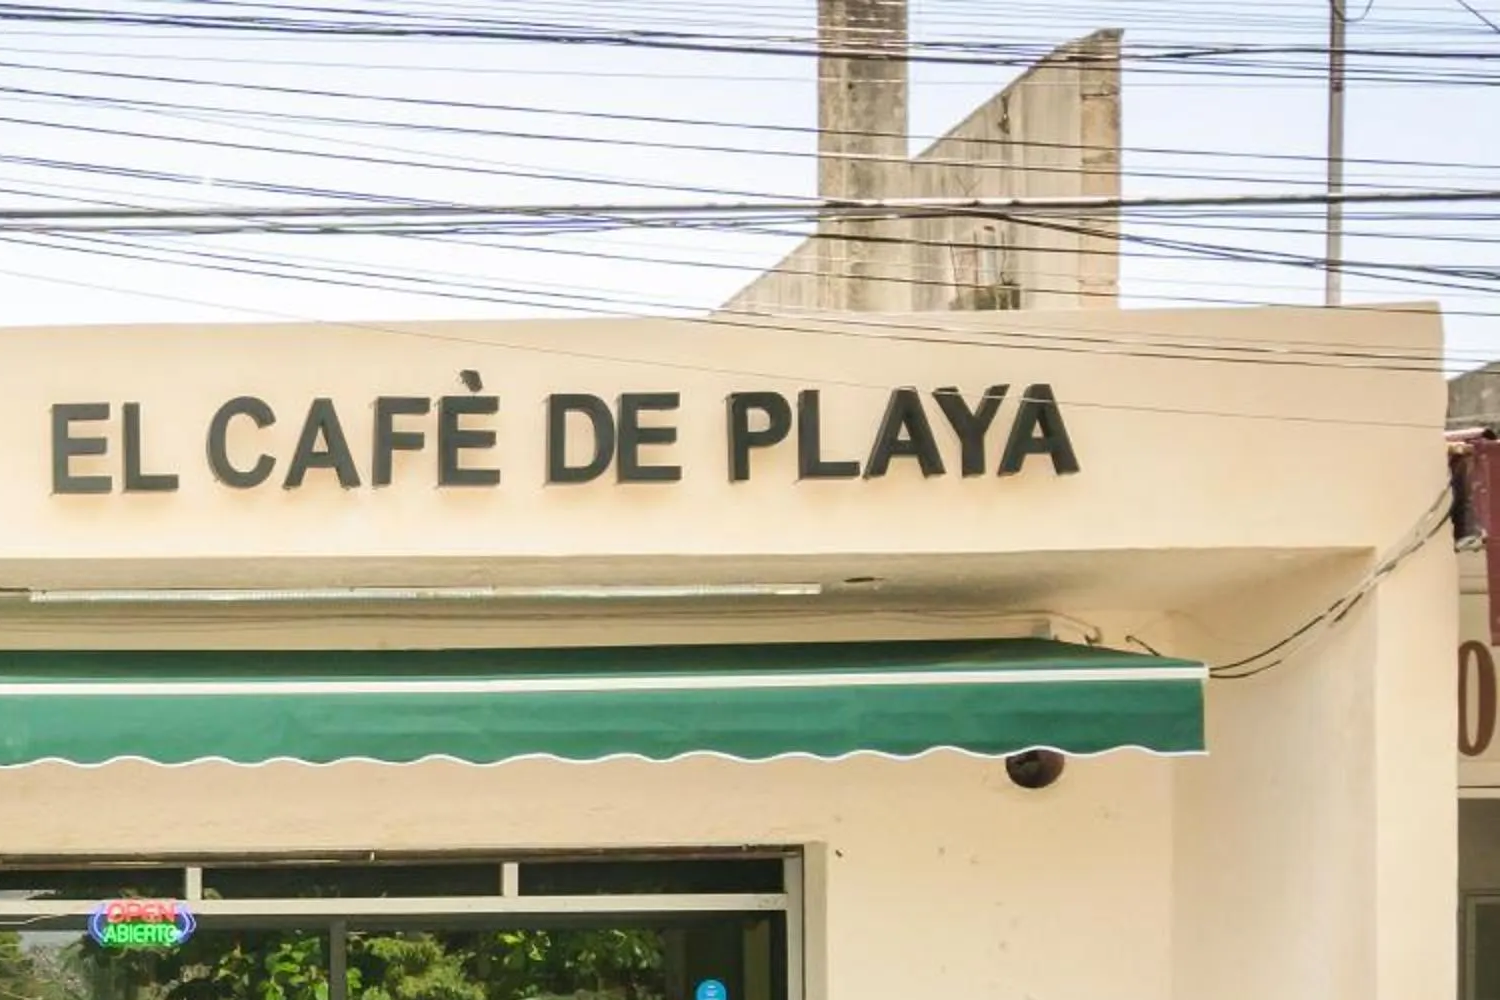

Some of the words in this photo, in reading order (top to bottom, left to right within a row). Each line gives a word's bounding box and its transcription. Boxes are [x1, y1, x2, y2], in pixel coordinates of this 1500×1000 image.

[52, 403, 179, 494] EL
[547, 392, 682, 484] DE
[725, 383, 1080, 483] PLAYA
[107, 899, 176, 923] OPEN
[103, 923, 178, 943] ABIERTO
